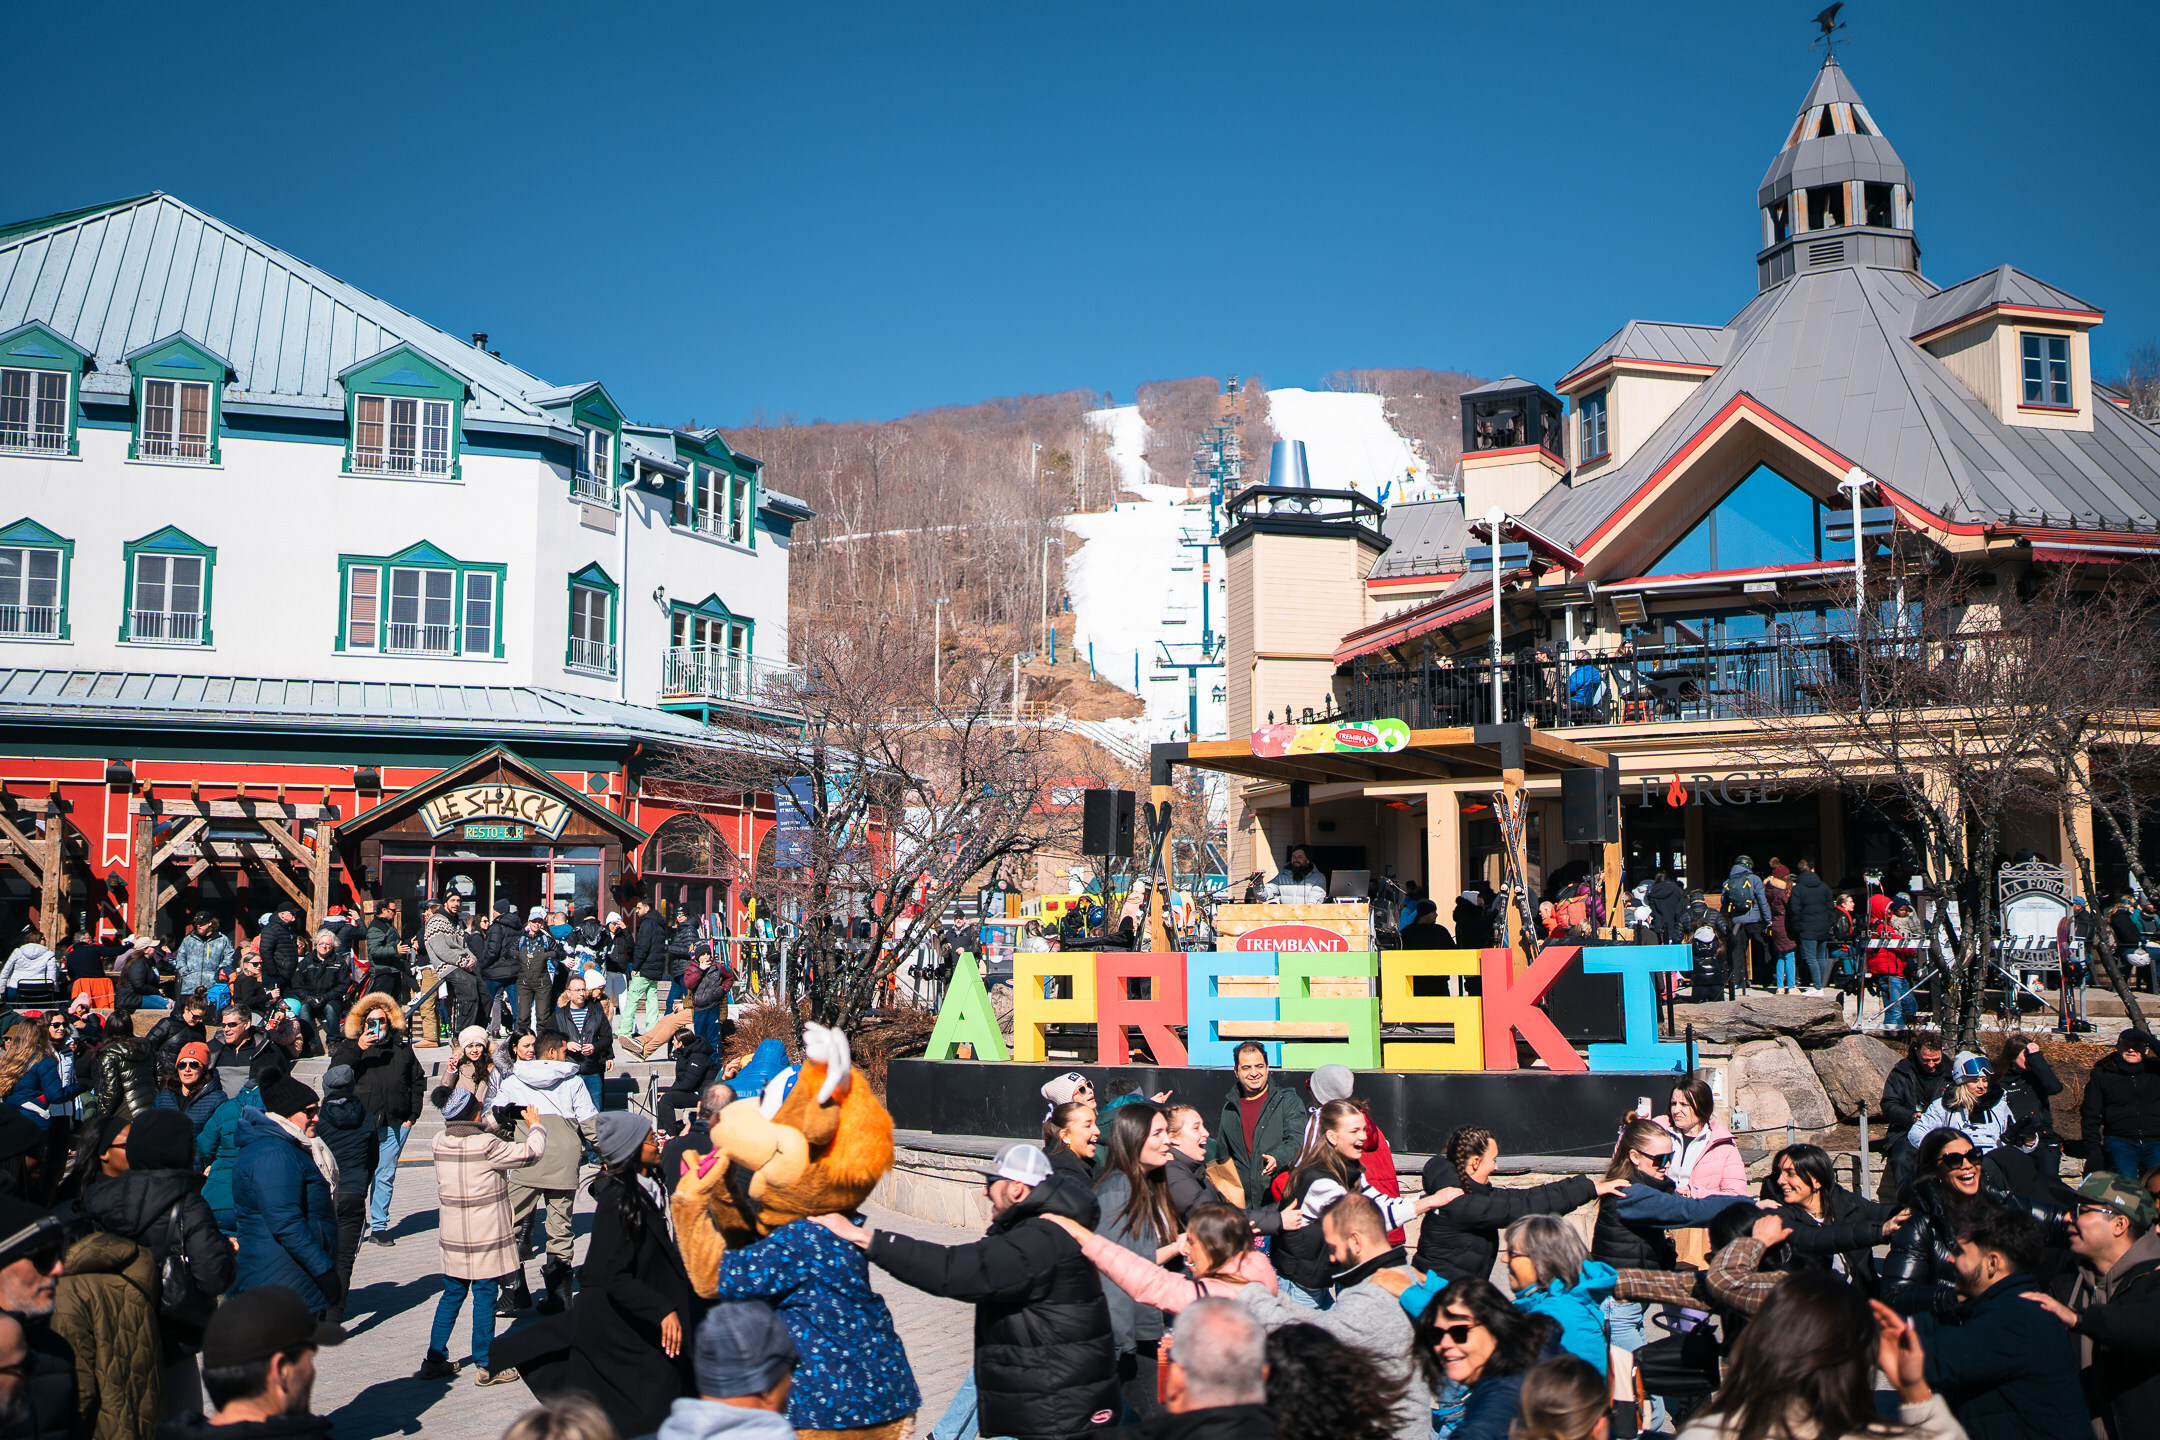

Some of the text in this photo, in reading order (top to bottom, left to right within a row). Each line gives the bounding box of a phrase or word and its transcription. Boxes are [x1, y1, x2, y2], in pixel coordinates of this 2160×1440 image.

[1338, 731, 1376, 747] TREMBLANT
[433, 788, 558, 826] LE SHACK
[2001, 878, 2071, 899] LA FORGE
[1243, 936, 1341, 952] TREMBLANT
